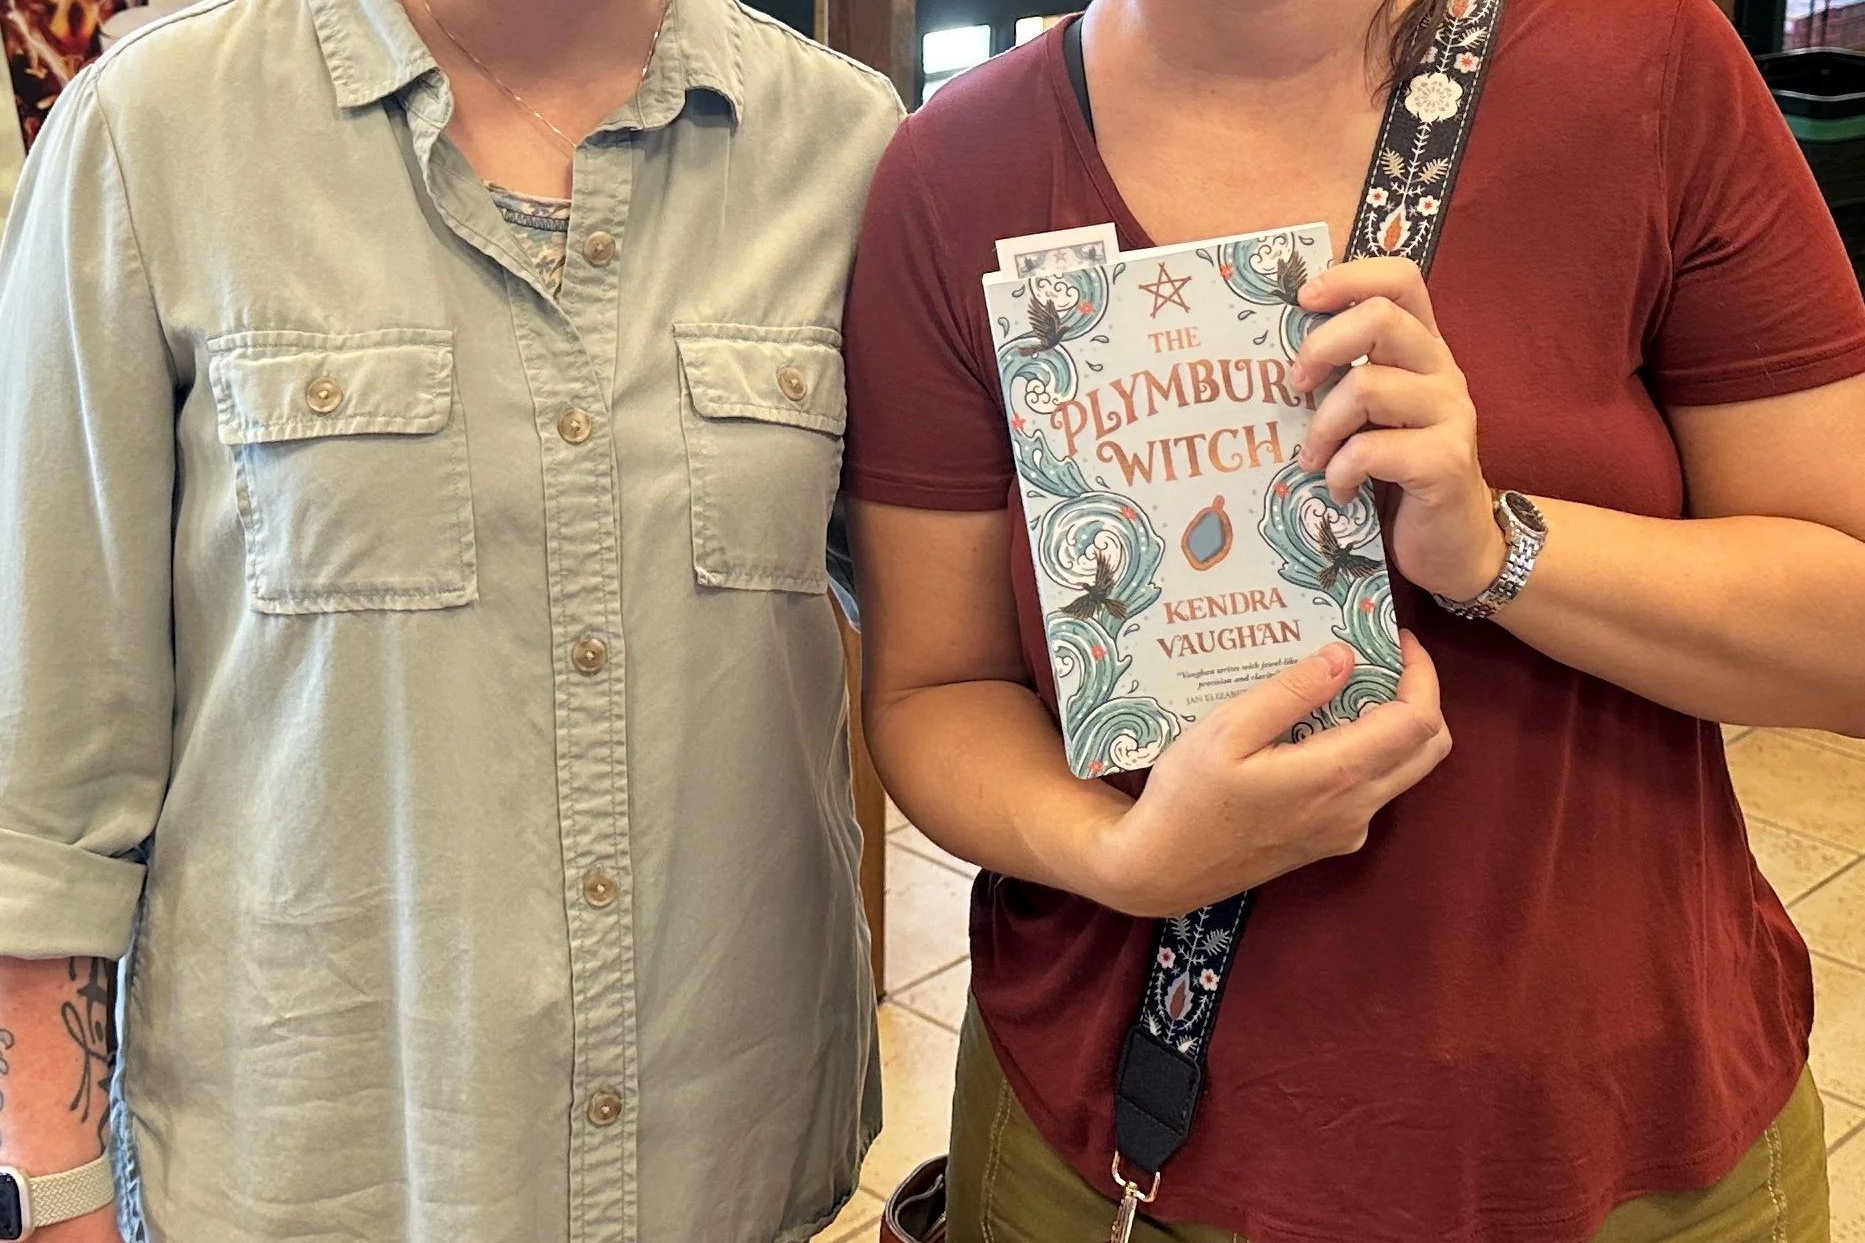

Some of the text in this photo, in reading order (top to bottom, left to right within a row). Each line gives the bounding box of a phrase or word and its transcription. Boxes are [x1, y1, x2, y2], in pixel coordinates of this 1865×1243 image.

[1148, 326, 1202, 353] THE
[1096, 420, 1284, 487] WITCH
[1163, 587, 1288, 625] KENDRA
[1156, 618, 1302, 660] VAUGHAN
[1233, 673, 1250, 683] and
